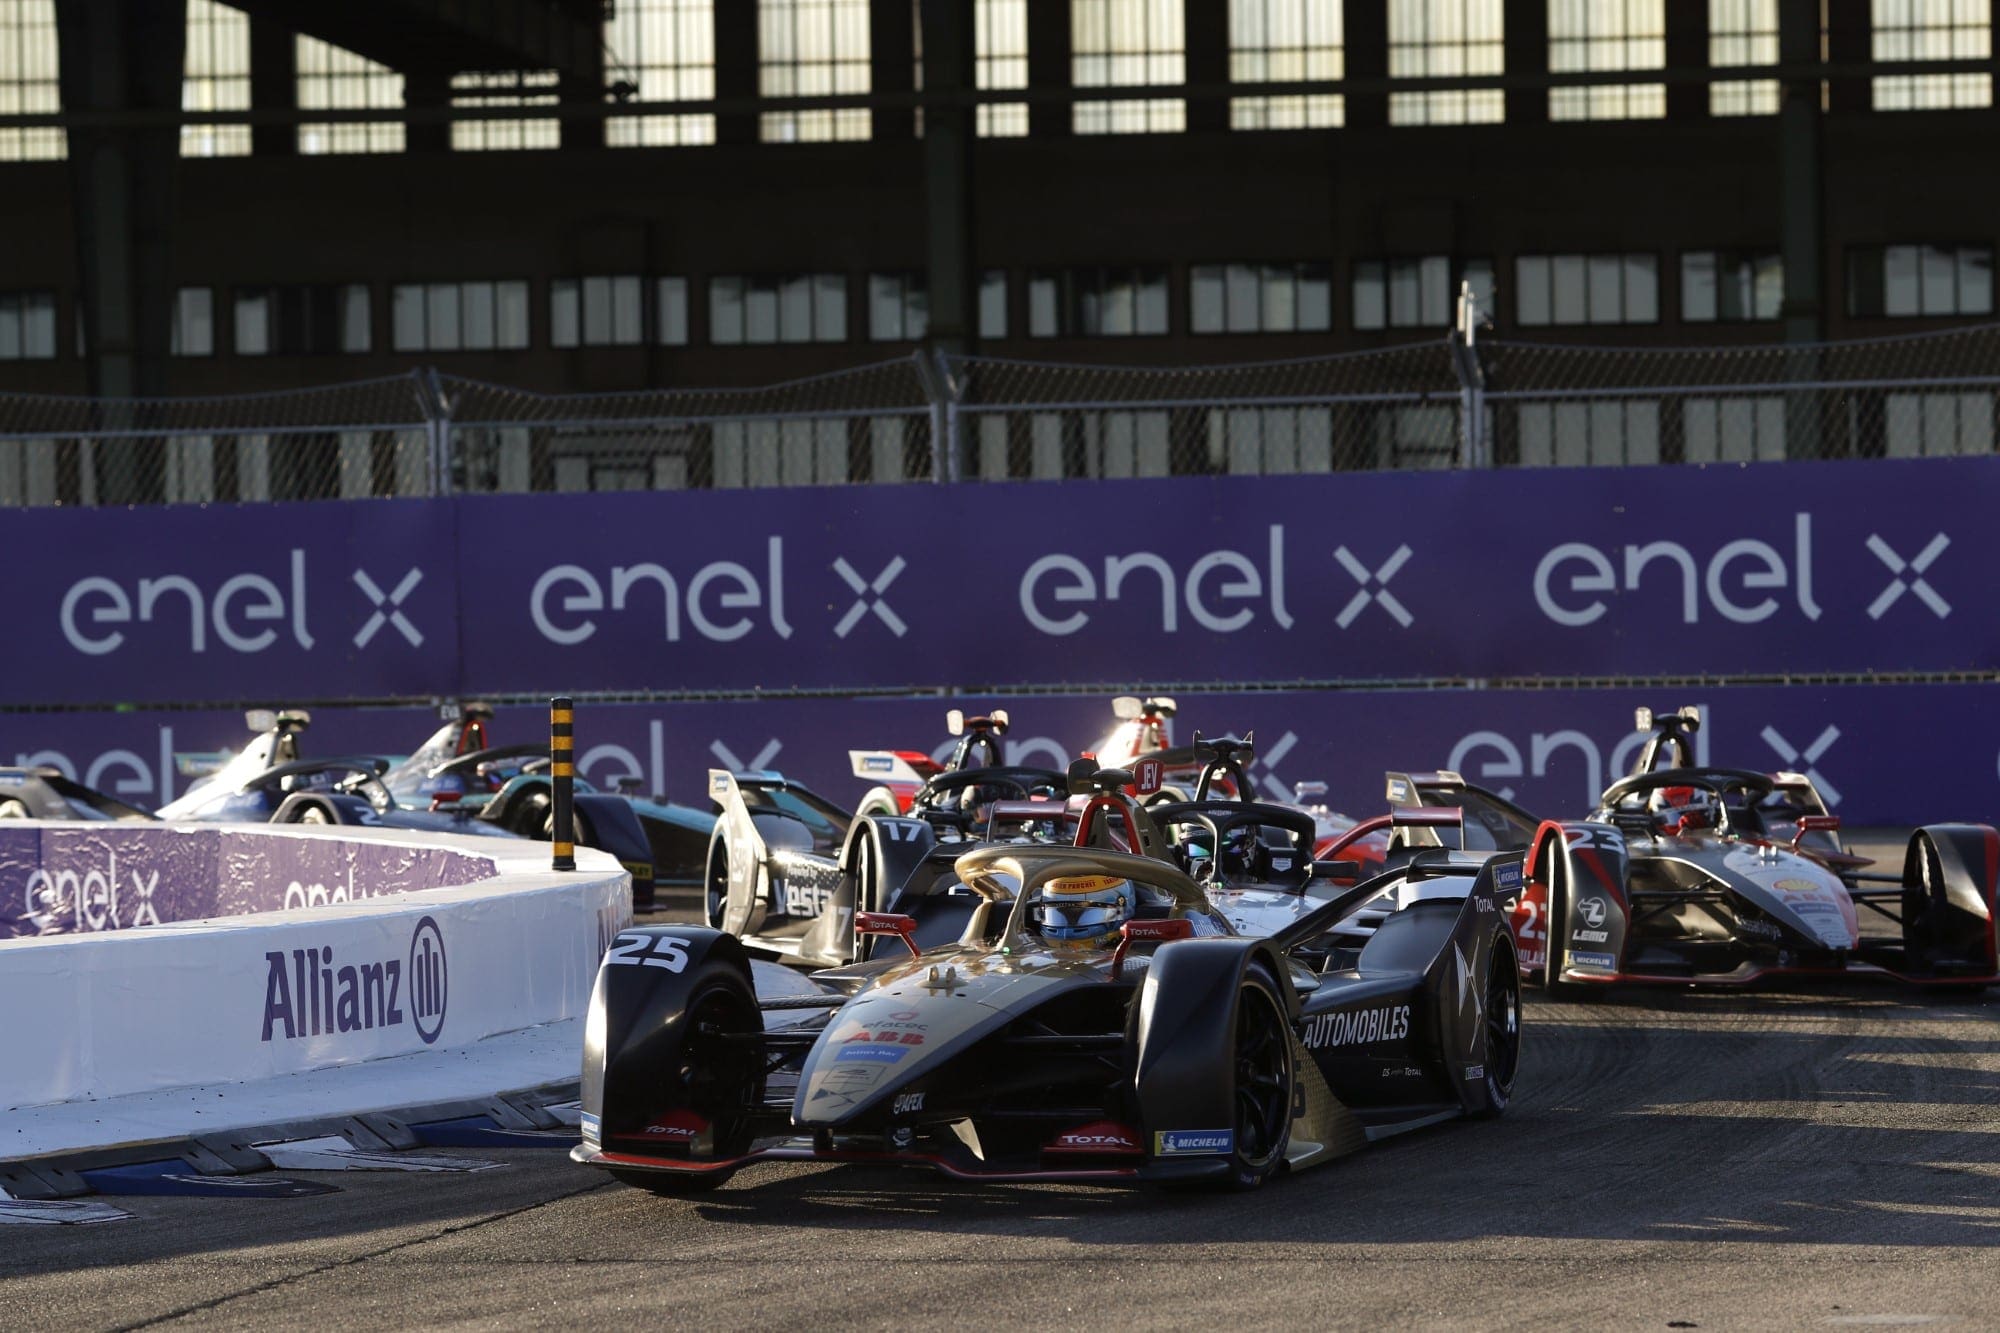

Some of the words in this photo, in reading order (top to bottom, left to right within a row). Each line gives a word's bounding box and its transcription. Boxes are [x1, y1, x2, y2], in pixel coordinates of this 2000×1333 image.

[1020, 525, 1293, 634] enel
[1534, 513, 1821, 625] enel
[62, 550, 313, 654] enel
[531, 537, 792, 643] enel
[1141, 763, 1159, 790] JEV
[883, 821, 922, 842] 17
[1565, 829, 1626, 855] 23
[25, 850, 121, 931] enel
[1474, 895, 1496, 913] TOTAL
[870, 920, 899, 930] TOTAL
[1130, 928, 1162, 936] TOTAL
[1572, 930, 1609, 943] LEMO
[607, 934, 691, 974] 25
[1576, 957, 1611, 966] MICHELIN
[261, 945, 403, 1042] Allianz
[842, 1031, 925, 1045] ABB
[1302, 1005, 1410, 1049] AUTOMOBILES
[1061, 1135, 1134, 1146] TOTAL
[1177, 1136, 1229, 1148] MICHELIN
